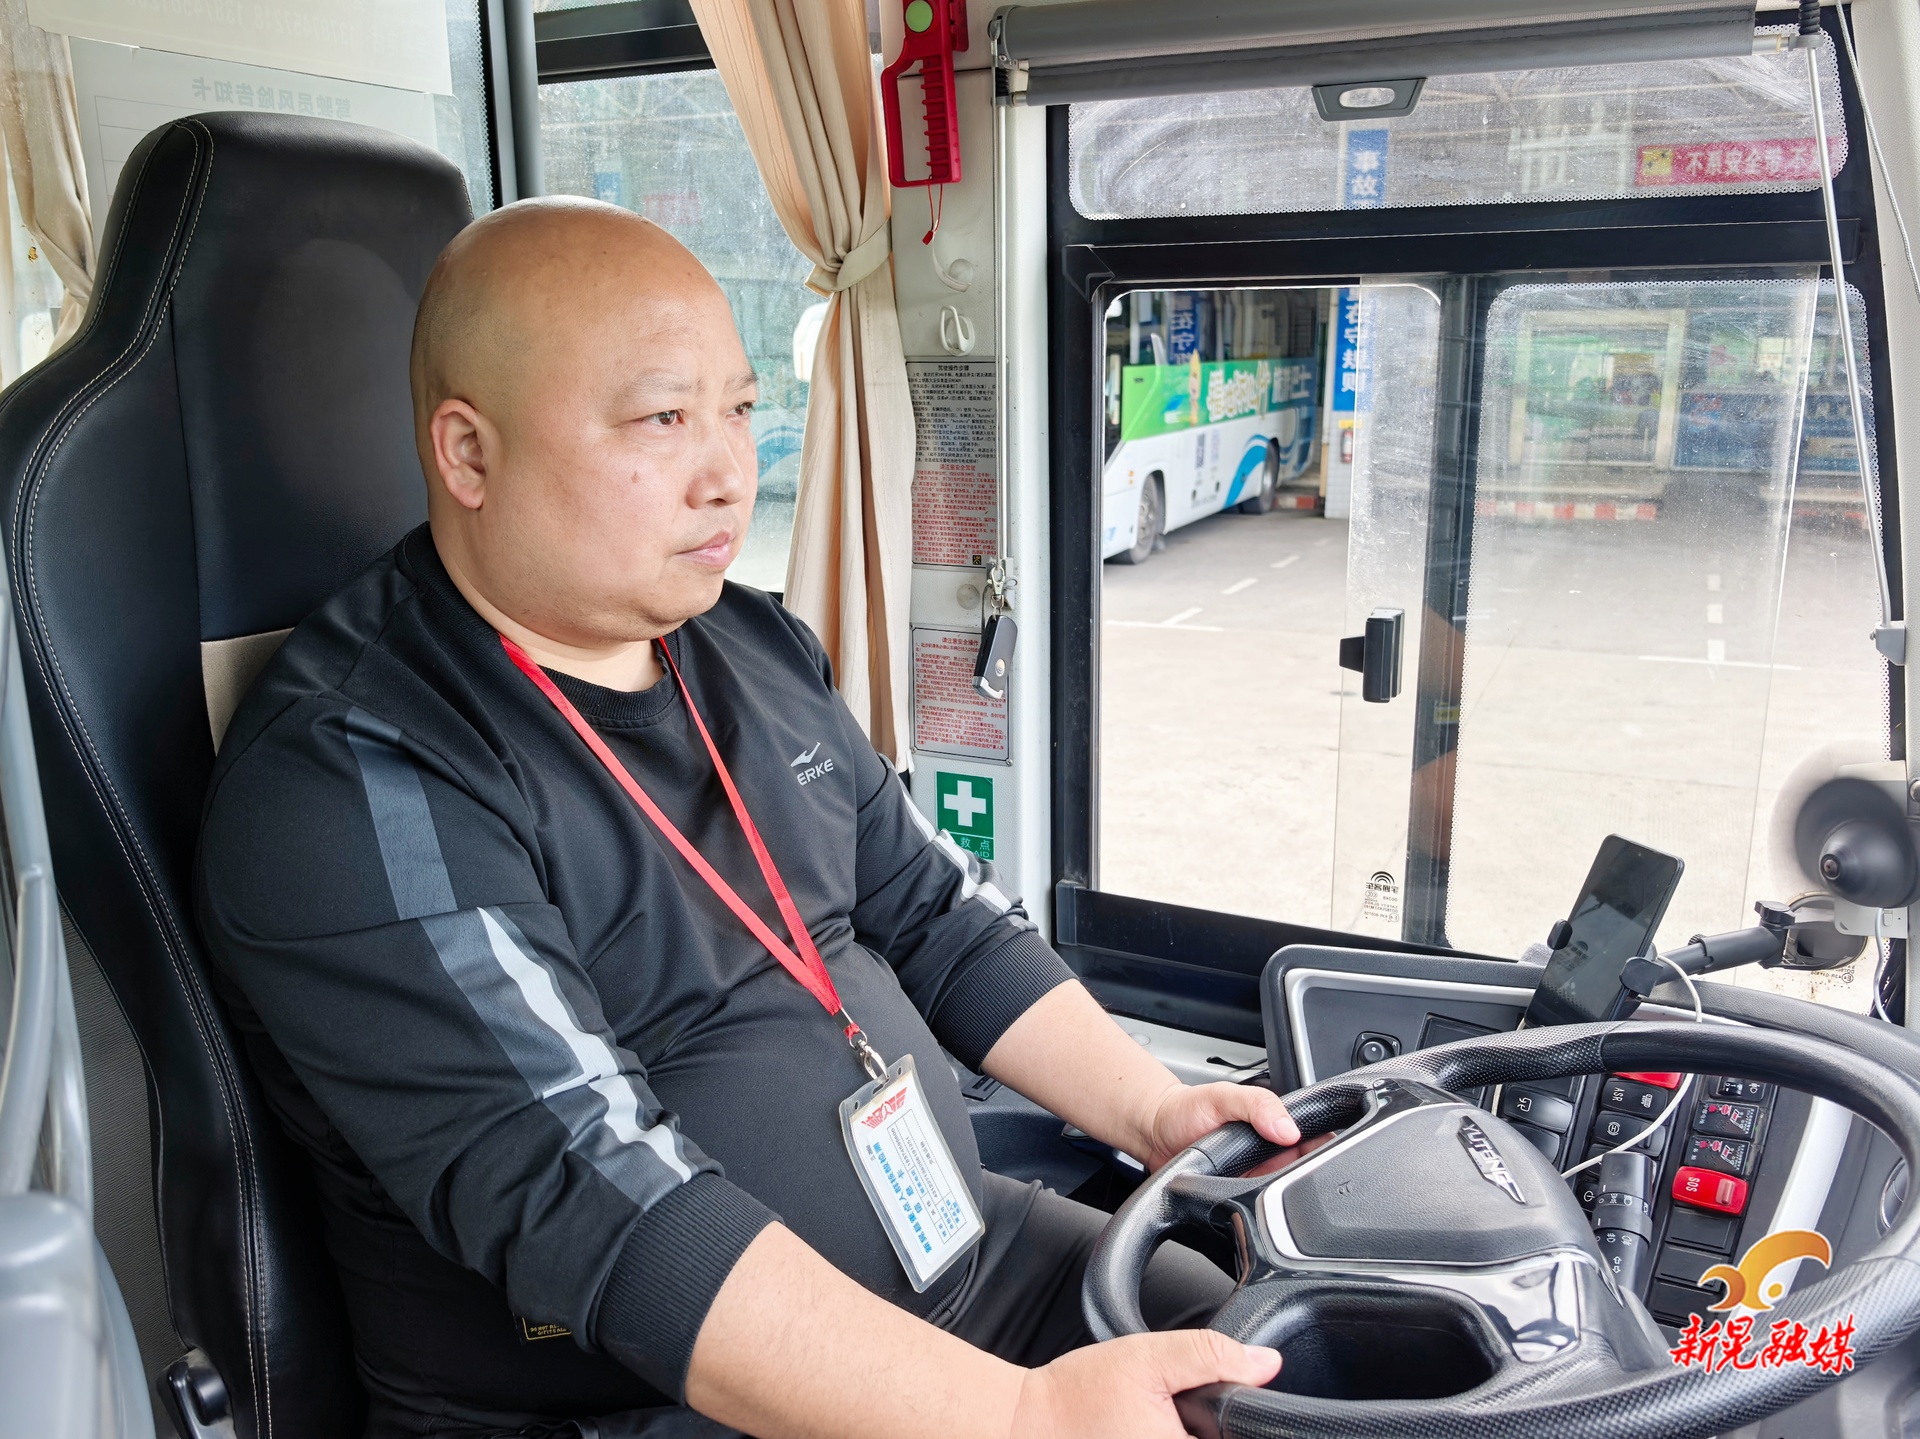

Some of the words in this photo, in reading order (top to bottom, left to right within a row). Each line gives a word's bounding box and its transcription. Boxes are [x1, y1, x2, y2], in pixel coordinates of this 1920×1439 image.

[1352, 150, 1383, 205] 事故
[797, 759, 834, 786] ERKE
[1612, 1089, 1625, 1102] ASR
[1686, 1176, 1700, 1193] SOS
